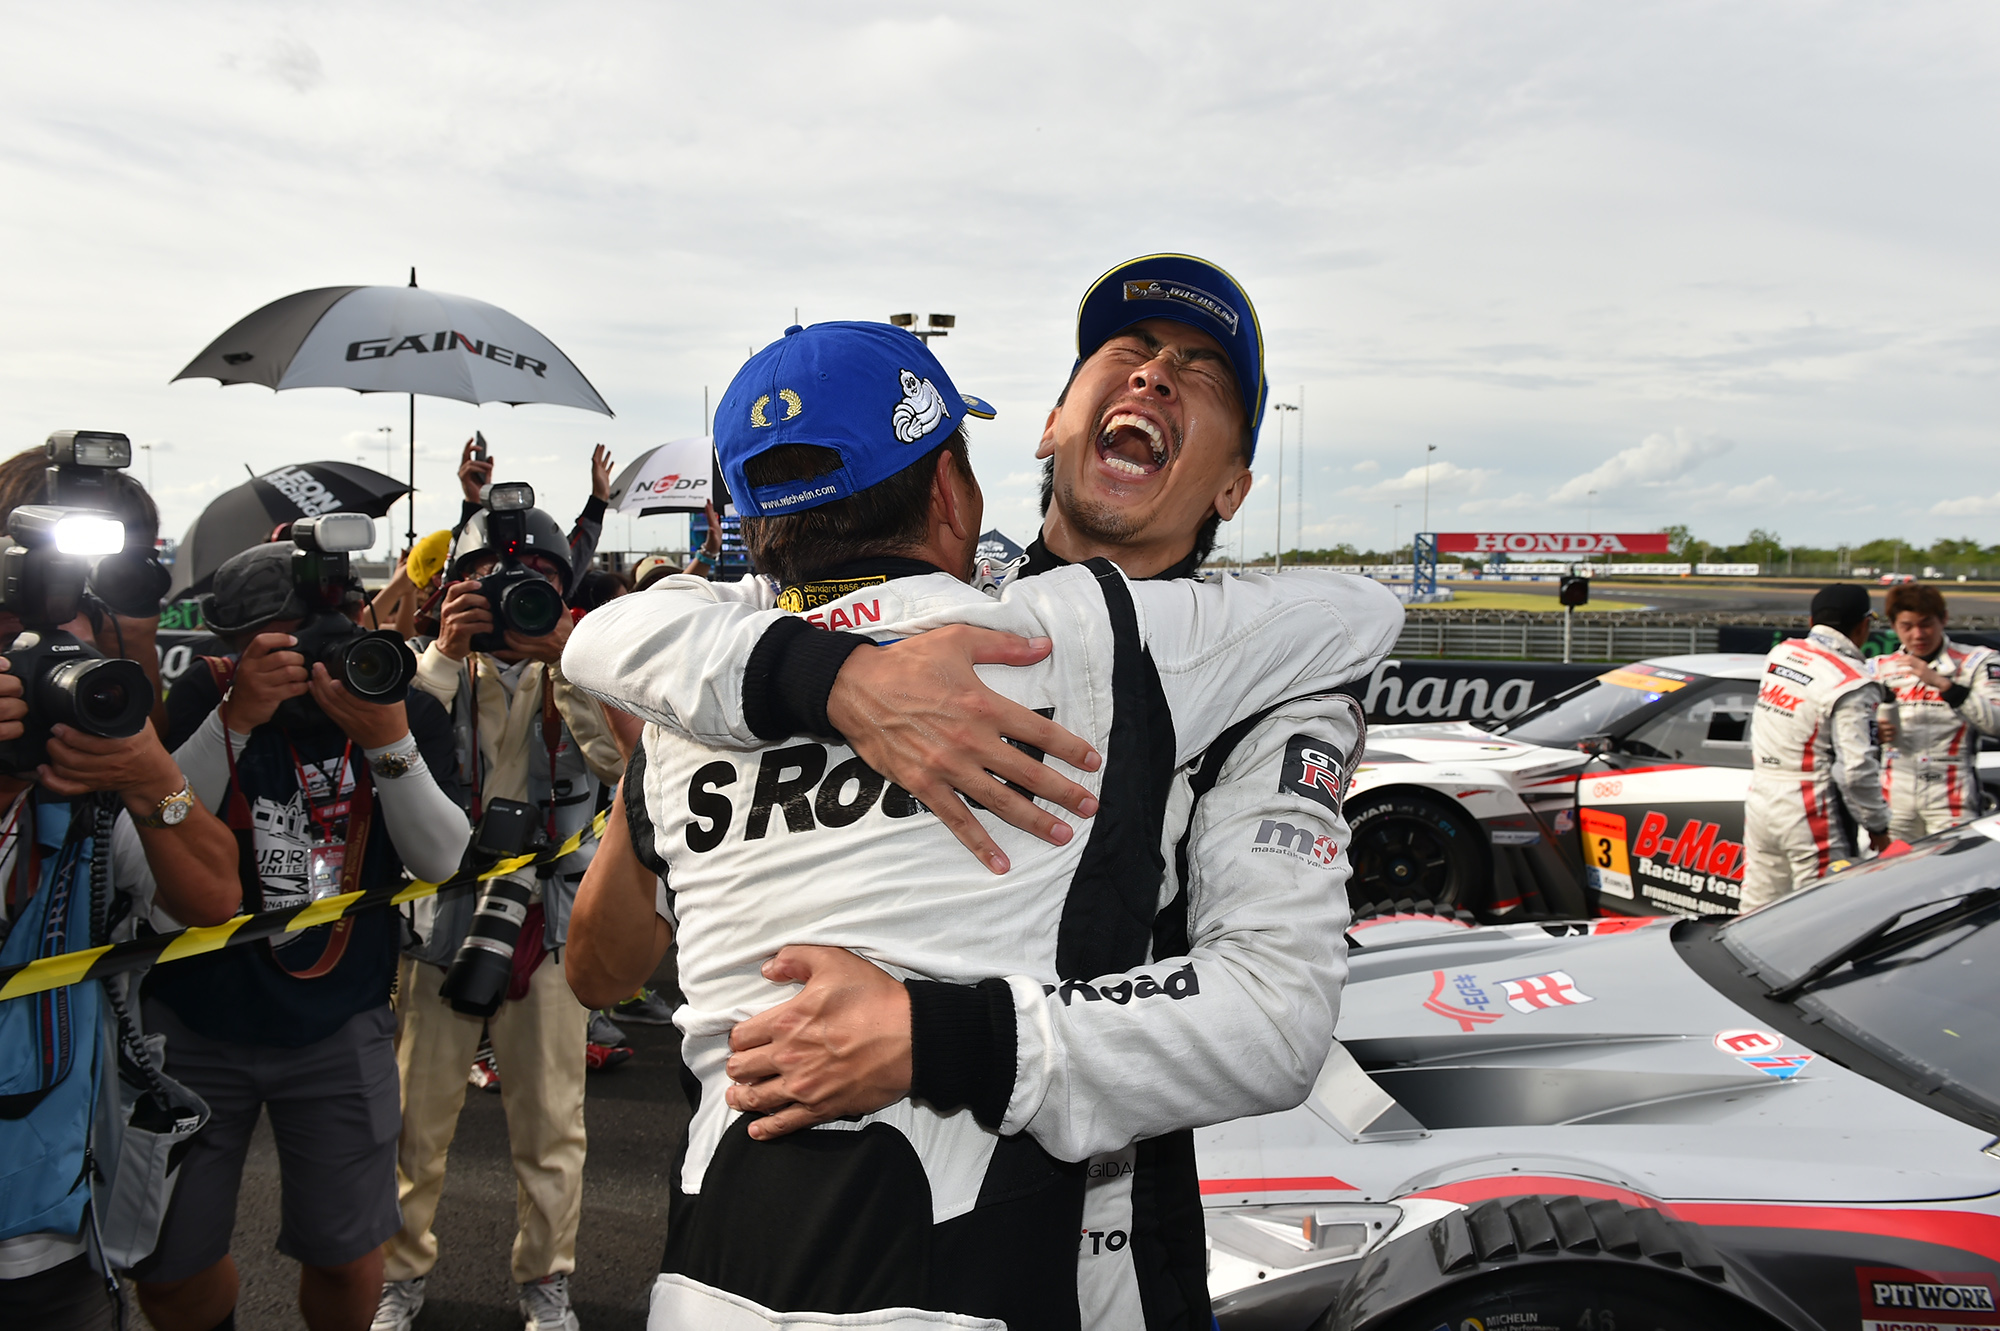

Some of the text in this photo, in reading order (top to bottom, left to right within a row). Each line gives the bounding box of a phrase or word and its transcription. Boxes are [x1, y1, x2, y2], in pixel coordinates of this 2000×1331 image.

[345, 330, 548, 378] GAINER
[276, 465, 343, 513] LEON
[759, 484, 837, 511] www.michelin.com
[1474, 533, 1627, 551] HONDA
[803, 583, 837, 593] Standard
[805, 599, 881, 632] SAN
[51, 644, 80, 652] Canon
[1362, 659, 1536, 720] hang
[1300, 748, 1344, 777] GT
[1298, 761, 1341, 806] R
[323, 805, 346, 816] MEIA
[1349, 803, 1393, 829] DVAN
[256, 849, 306, 864] URIR
[1598, 838, 1612, 868] 3
[1638, 857, 1705, 893] Racing
[1706, 875, 1741, 899] tea
[46, 859, 76, 939] JRPA
[1088, 1161, 1133, 1178] GIDA
[1079, 1229, 1128, 1255] TO
[1485, 1313, 1539, 1328] MICHELIN
